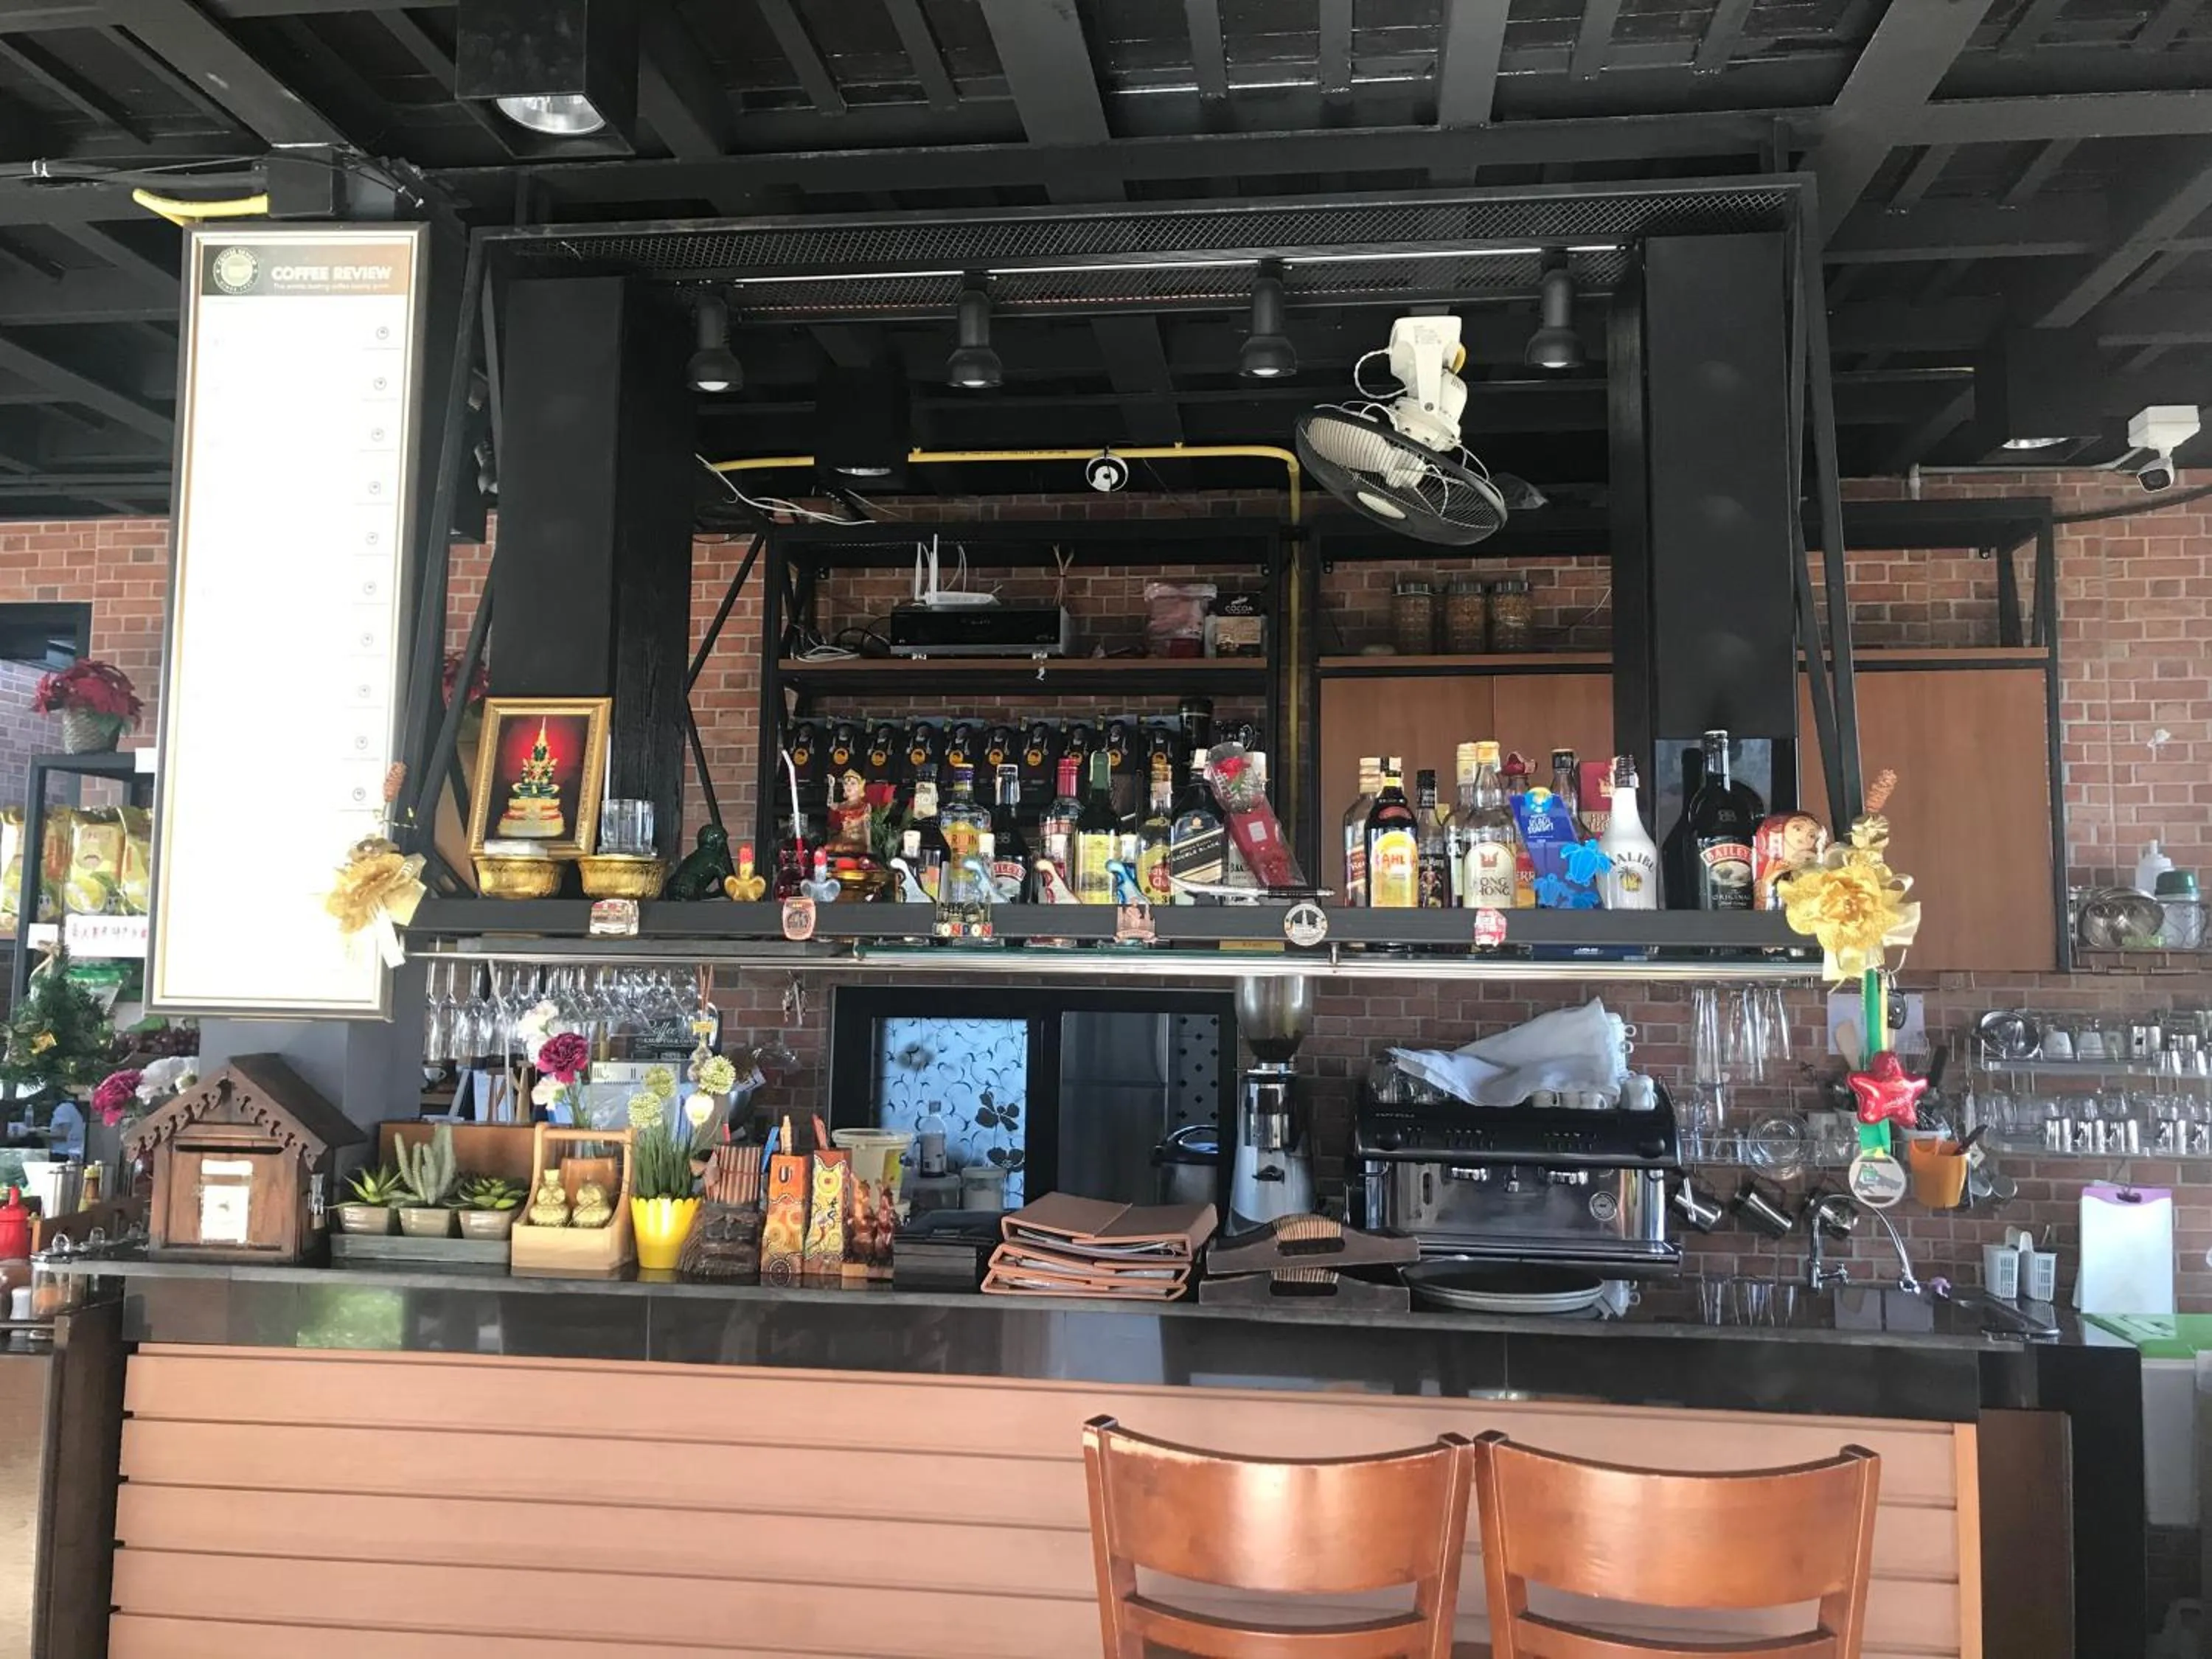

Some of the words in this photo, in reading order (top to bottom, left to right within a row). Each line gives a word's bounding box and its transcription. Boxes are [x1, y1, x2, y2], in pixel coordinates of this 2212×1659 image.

[271, 266, 329, 281] COFFEE
[333, 265, 392, 280] REVIEW
[1225, 605, 1253, 613] COCOA
[1705, 846, 1752, 862] BAILEY
[1474, 877, 1508, 886] ONG
[931, 922, 992, 937] LONDON
